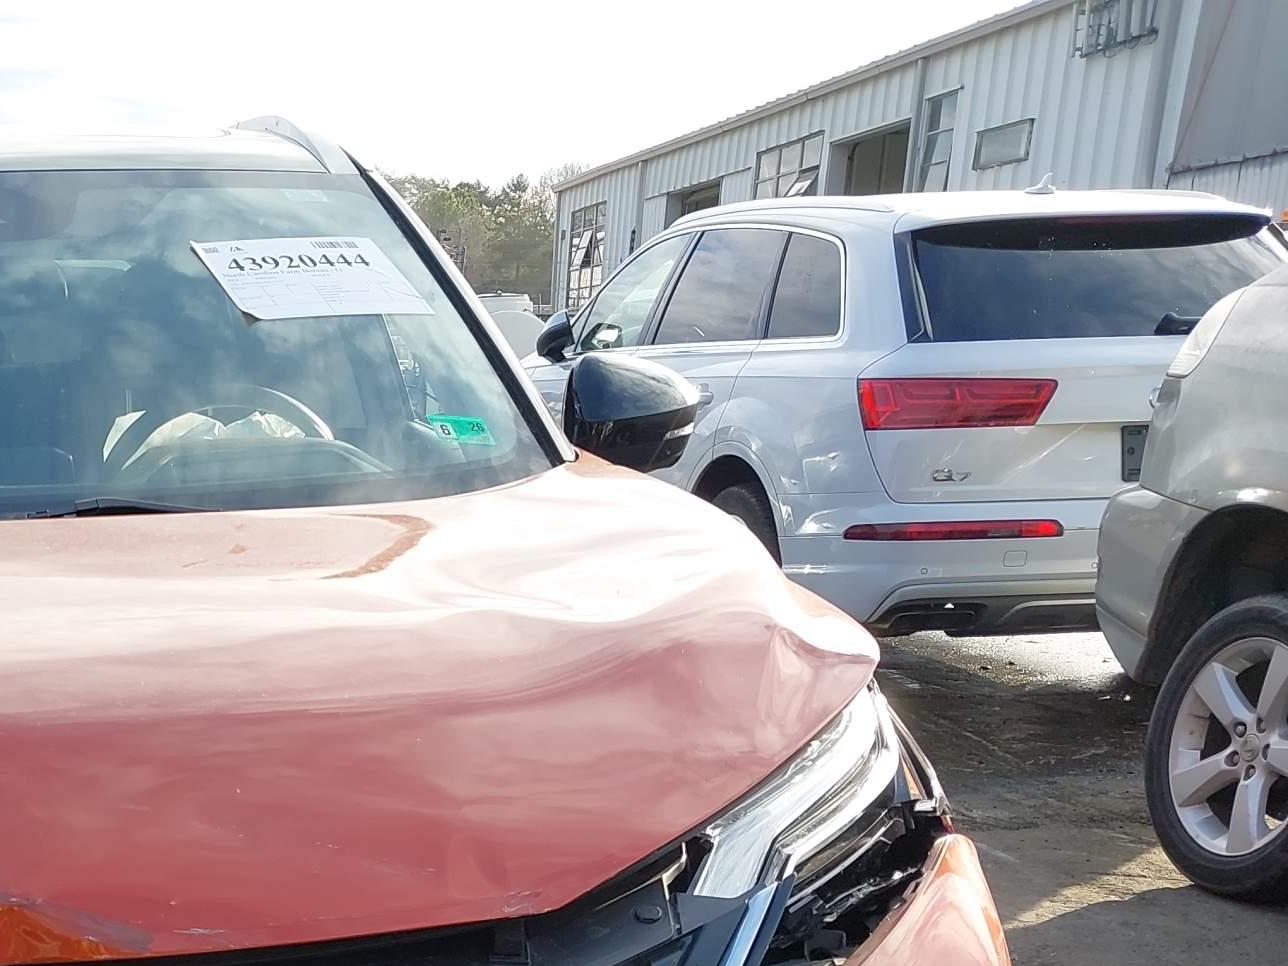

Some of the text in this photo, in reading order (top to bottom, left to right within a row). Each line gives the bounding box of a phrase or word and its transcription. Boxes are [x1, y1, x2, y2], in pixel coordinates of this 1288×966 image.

[228, 253, 370, 272] 43920444
[440, 424, 451, 436] 6
[932, 468, 972, 482] Q7
